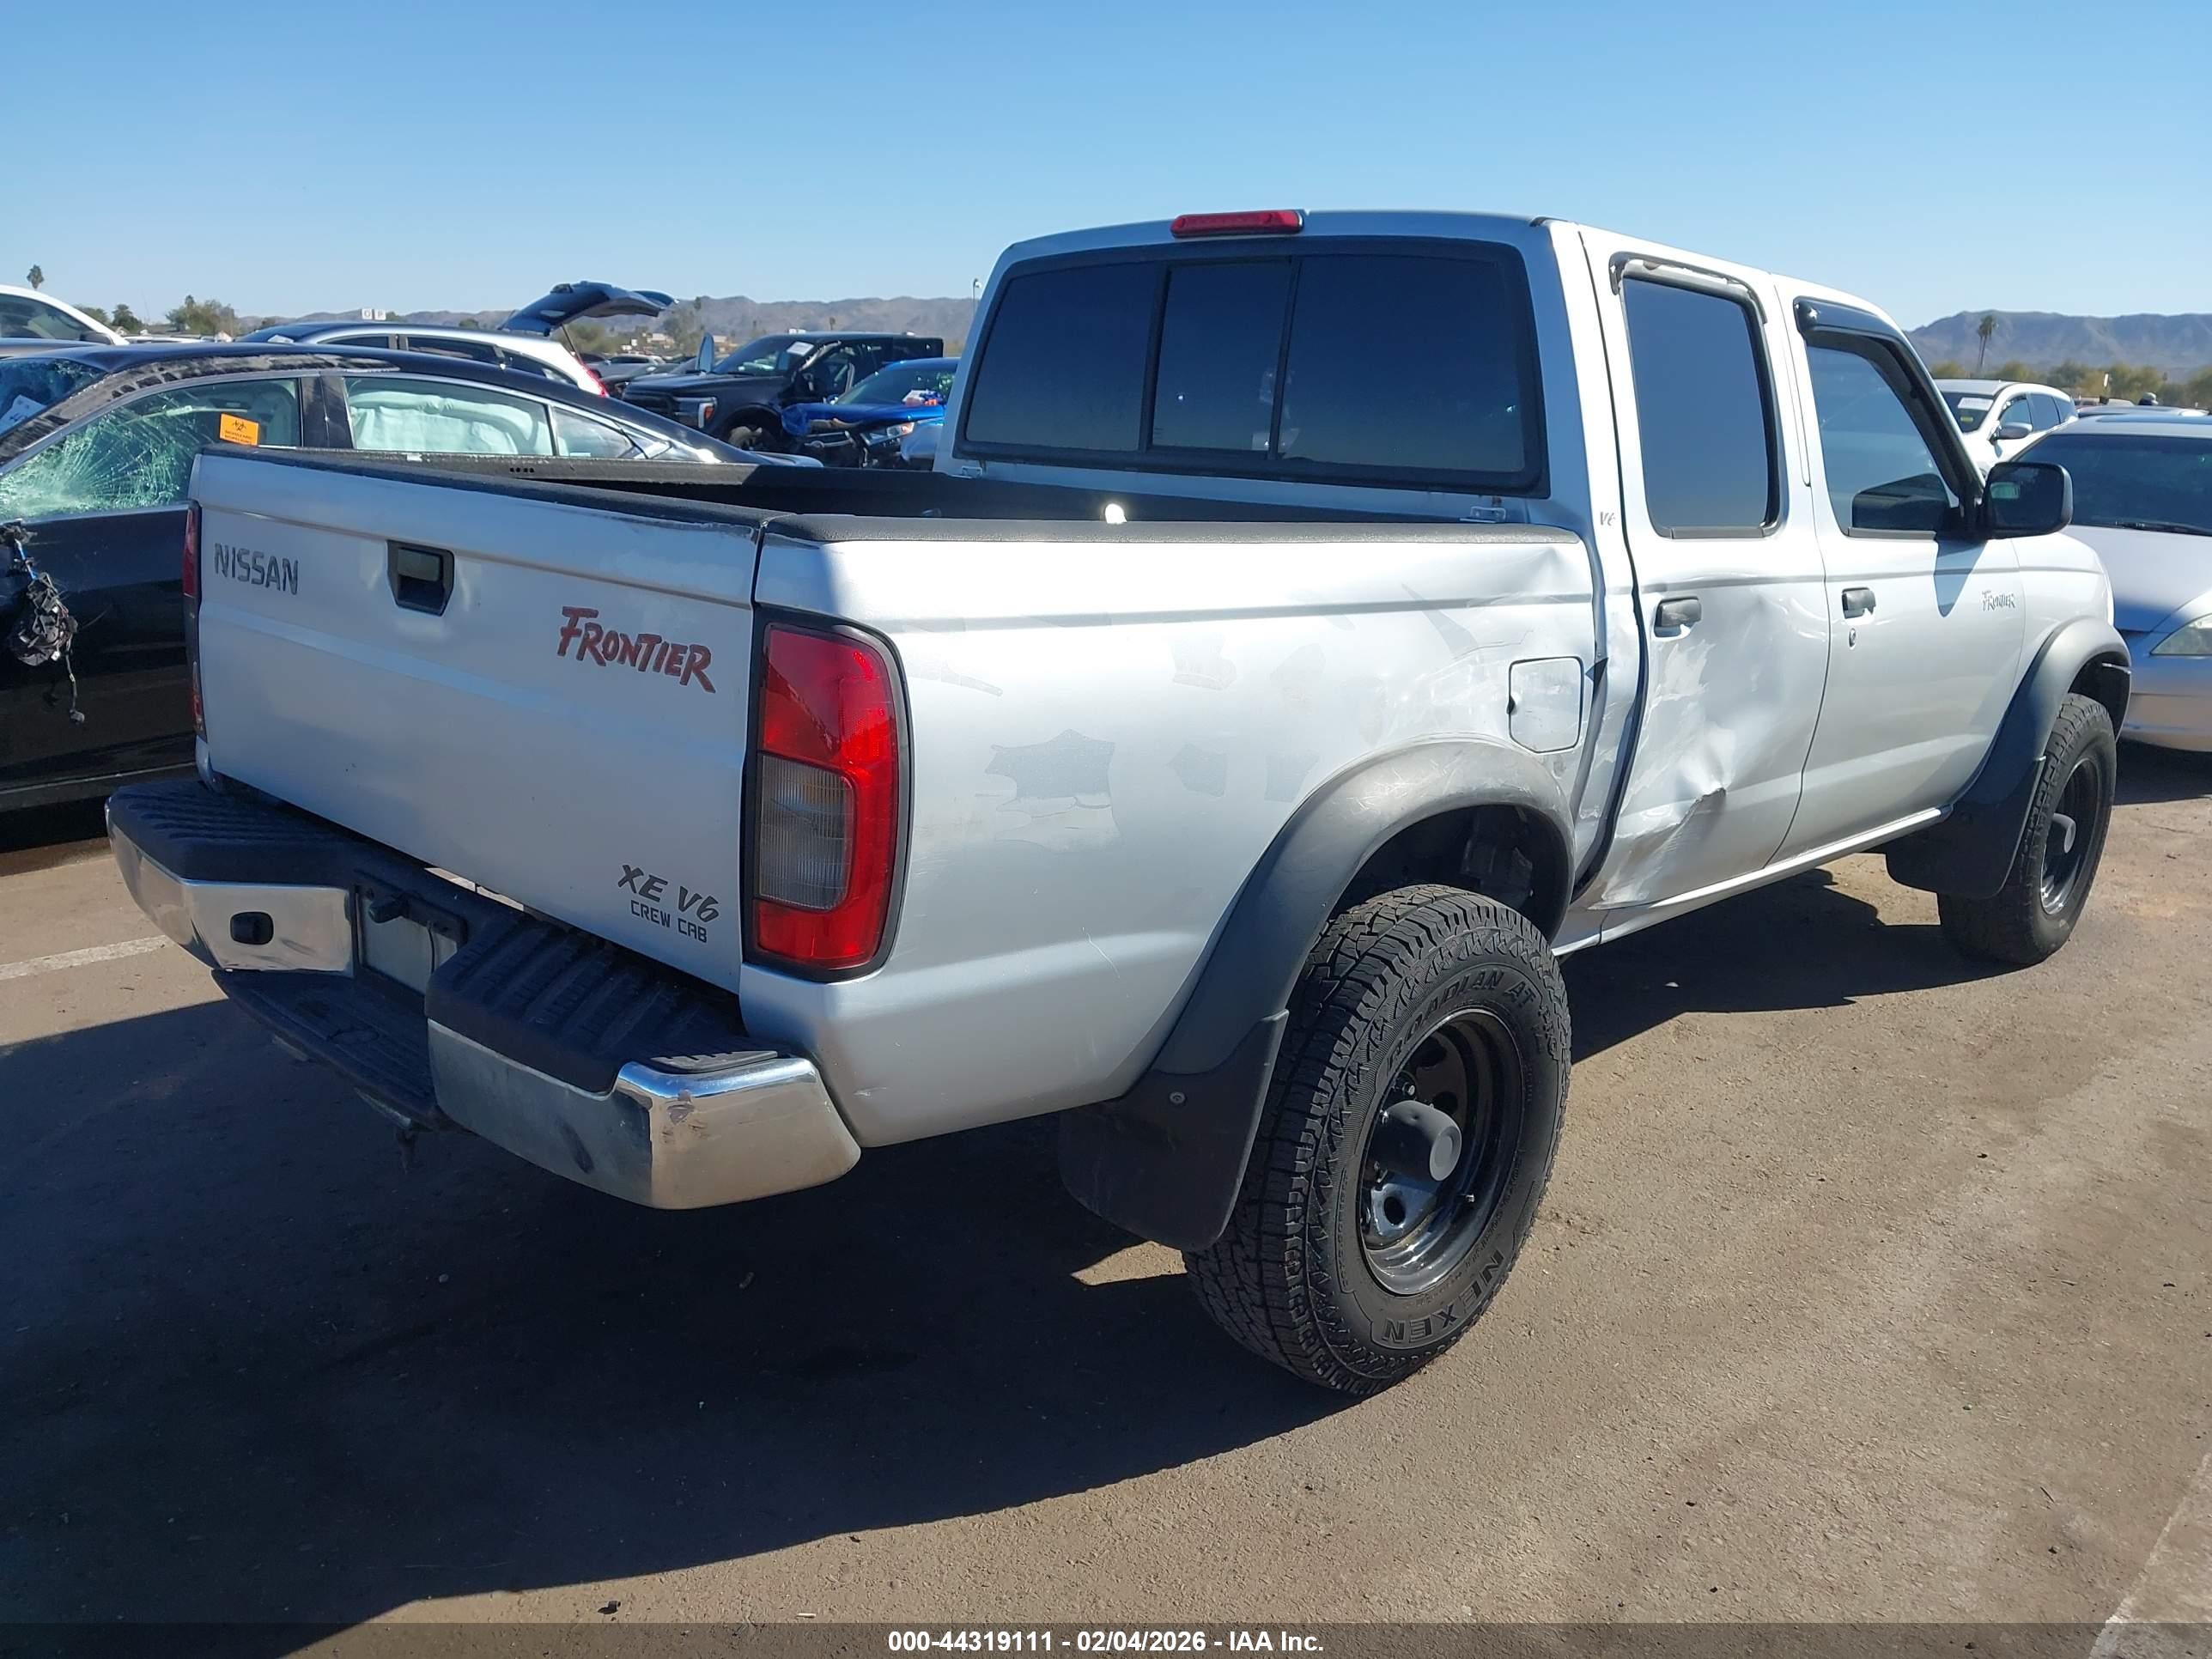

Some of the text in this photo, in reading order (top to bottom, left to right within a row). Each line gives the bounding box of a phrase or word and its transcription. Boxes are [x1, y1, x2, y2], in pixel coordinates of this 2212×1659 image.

[214, 543, 299, 596] NISSAN
[556, 605, 716, 694] FRONTIER
[617, 864, 720, 922] XE V6
[630, 899, 708, 944] CREW CAB
[1386, 969, 1504, 1073] ROADIAN
[1381, 1249, 1505, 1344] NEXEN
